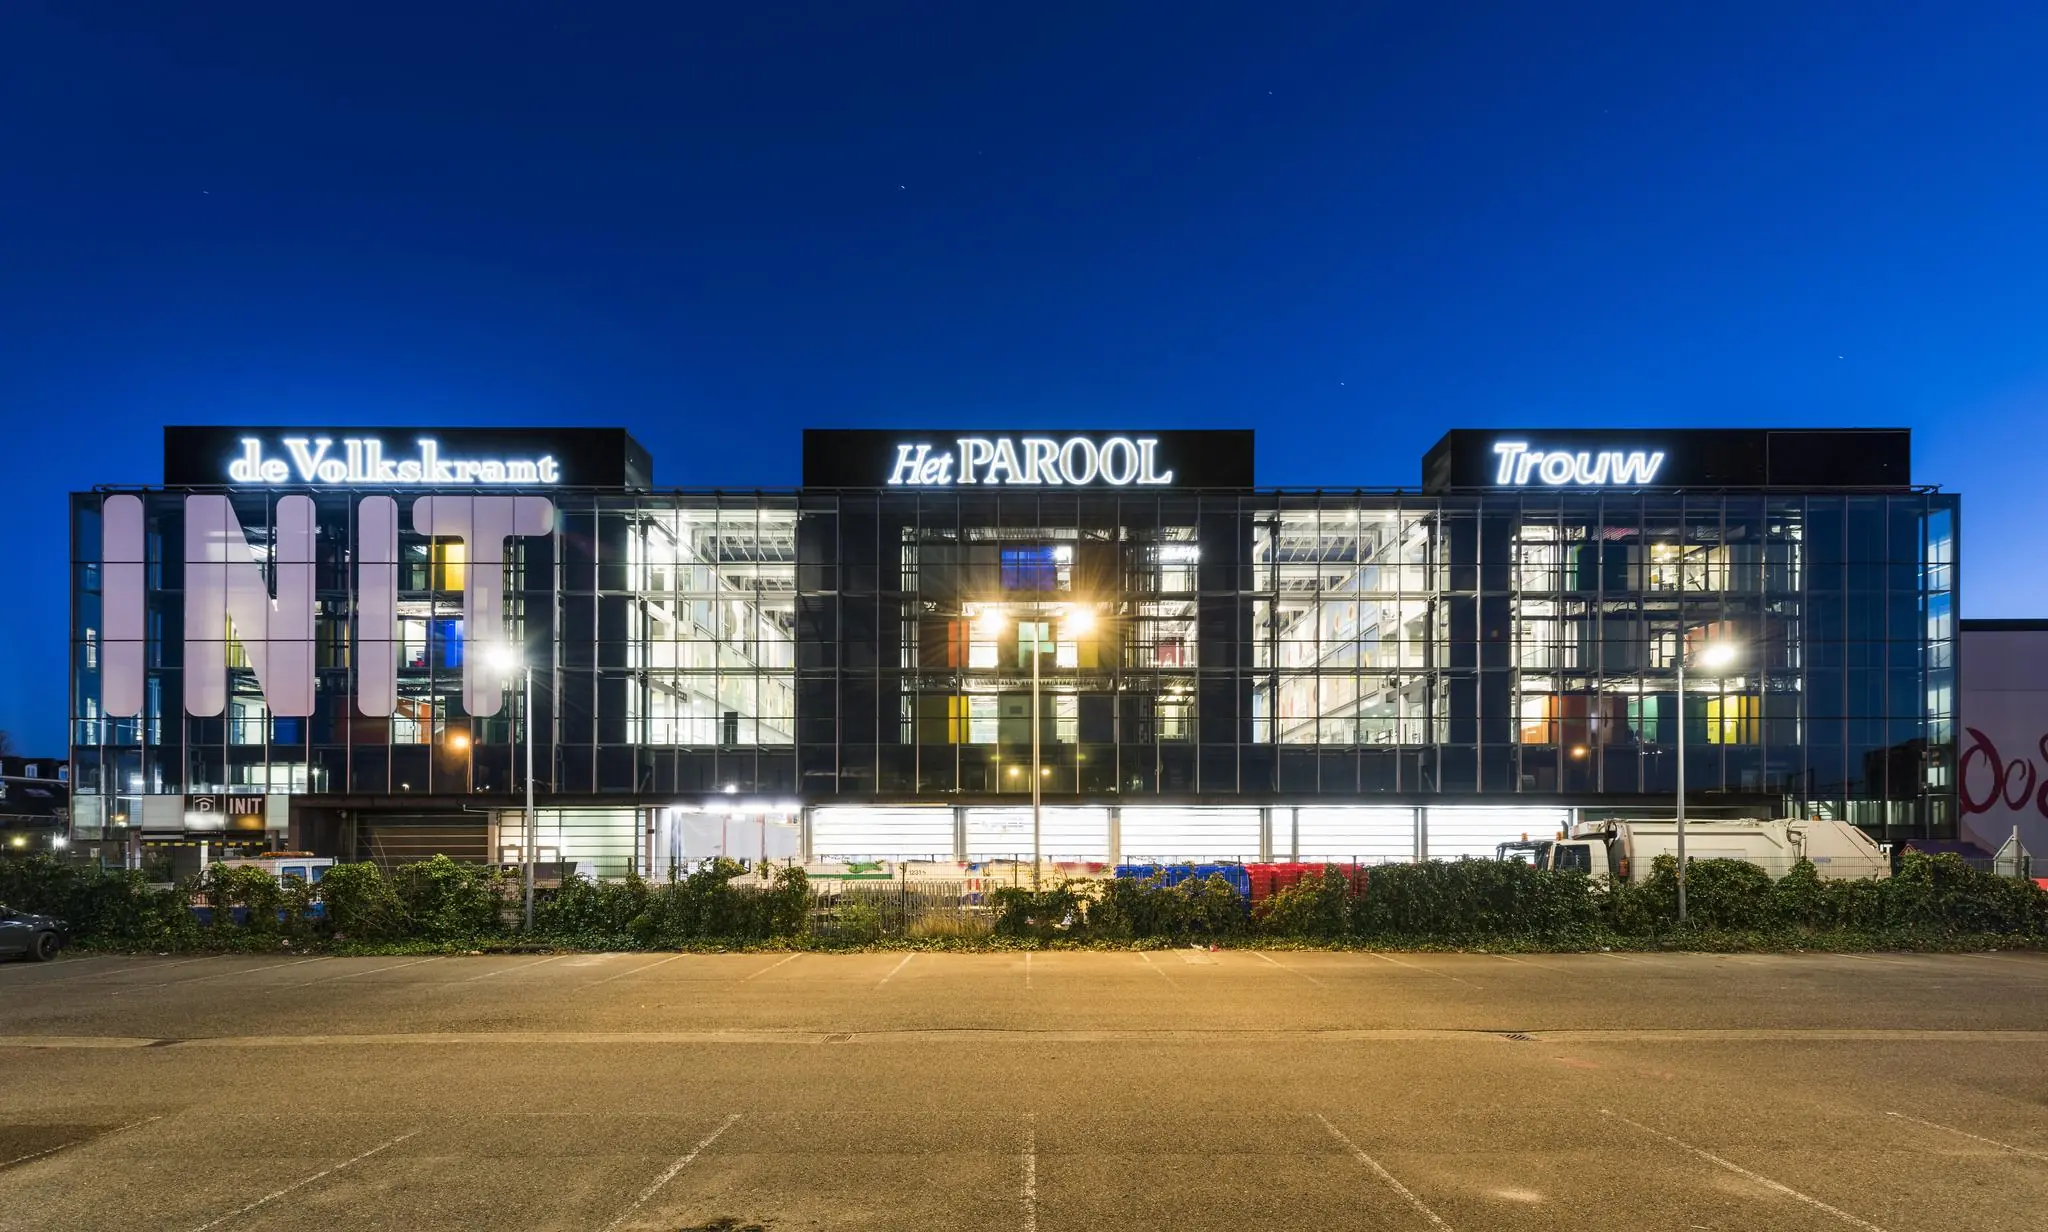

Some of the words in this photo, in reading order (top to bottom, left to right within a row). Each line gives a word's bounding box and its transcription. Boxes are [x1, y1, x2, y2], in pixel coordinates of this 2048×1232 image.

[228, 438, 289, 482] de
[284, 438, 560, 483] Volkskrant
[887, 444, 953, 485] Het
[957, 437, 1173, 485] PAROOL
[1494, 442, 1665, 485] Trouw
[103, 494, 554, 717] INIT
[229, 797, 262, 815] INIT
